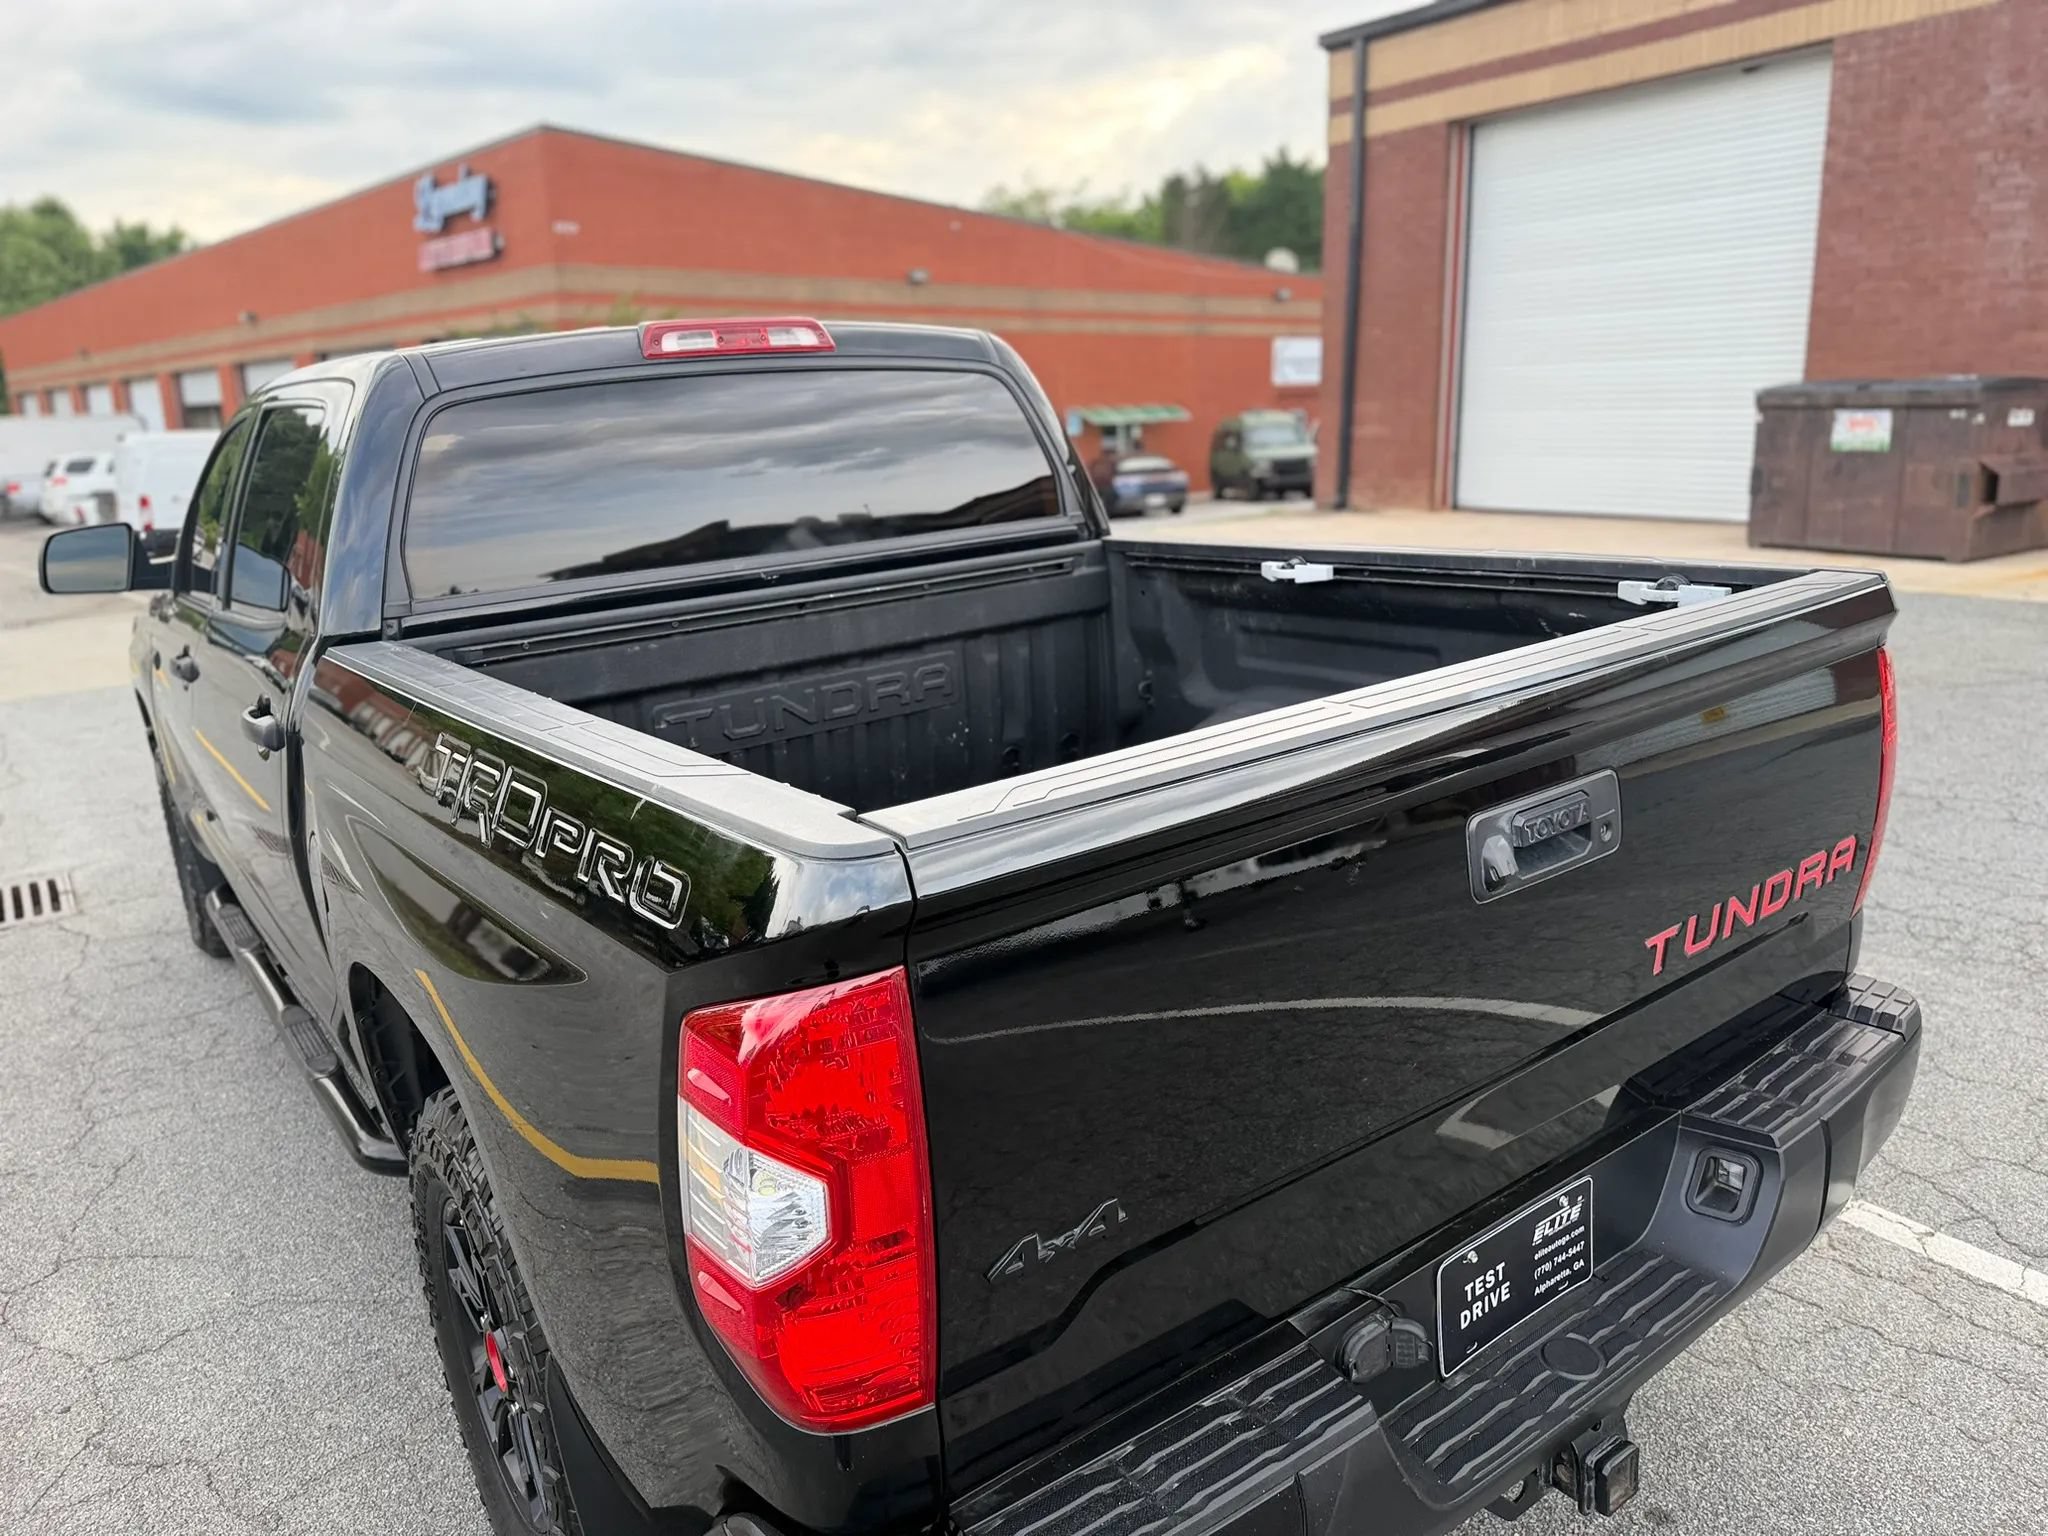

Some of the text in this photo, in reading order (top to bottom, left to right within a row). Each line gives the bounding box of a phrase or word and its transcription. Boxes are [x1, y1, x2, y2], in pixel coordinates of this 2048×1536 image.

[661, 662, 952, 750] TUNDRA
[434, 731, 692, 930] TRD PRO
[1523, 801, 1590, 843] TOYOTA
[1644, 834, 1859, 977] TUNDRA
[1532, 1202, 1584, 1247] ELITE
[1534, 1225, 1585, 1260] eliteautoga.com
[1464, 1261, 1506, 1302] TEST
[1534, 1240, 1585, 1280] (770) 744-5447
[1534, 1258, 1585, 1296] Alpharetta, GA
[1460, 1281, 1511, 1330] DRIVE
